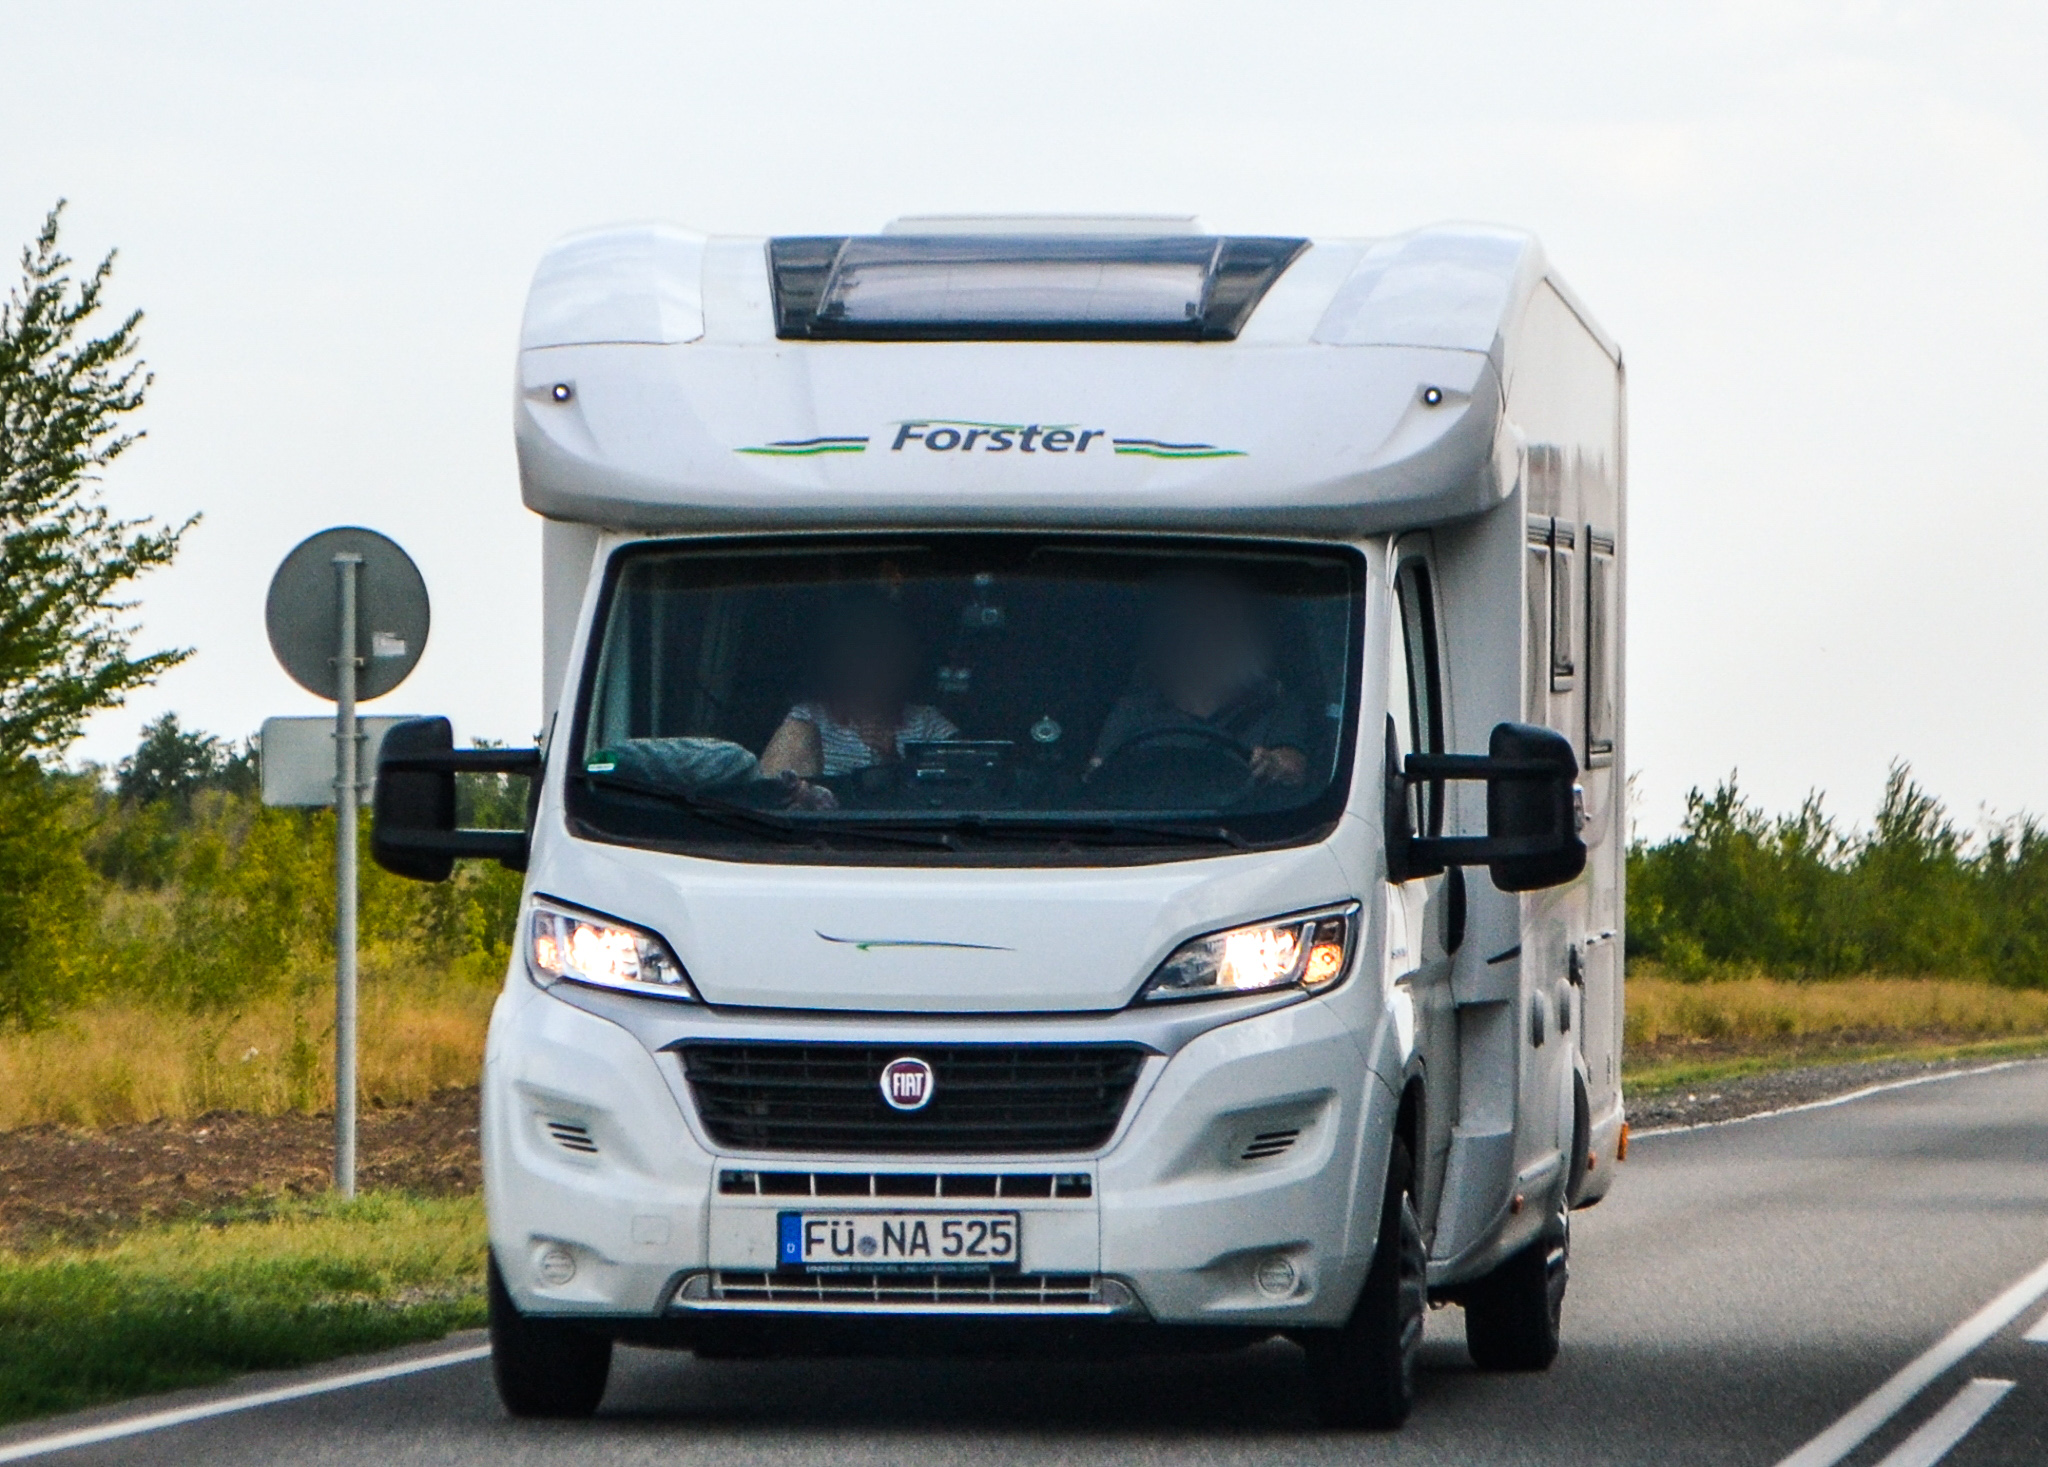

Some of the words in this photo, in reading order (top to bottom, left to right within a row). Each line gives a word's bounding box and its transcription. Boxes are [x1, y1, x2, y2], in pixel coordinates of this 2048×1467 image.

[891, 423, 1104, 452] Forster
[893, 1072, 924, 1097] FIAT
[786, 1243, 796, 1254] D
[805, 1220, 854, 1257] FÜ
[882, 1220, 931, 1257] NA
[941, 1220, 1012, 1257] 525
